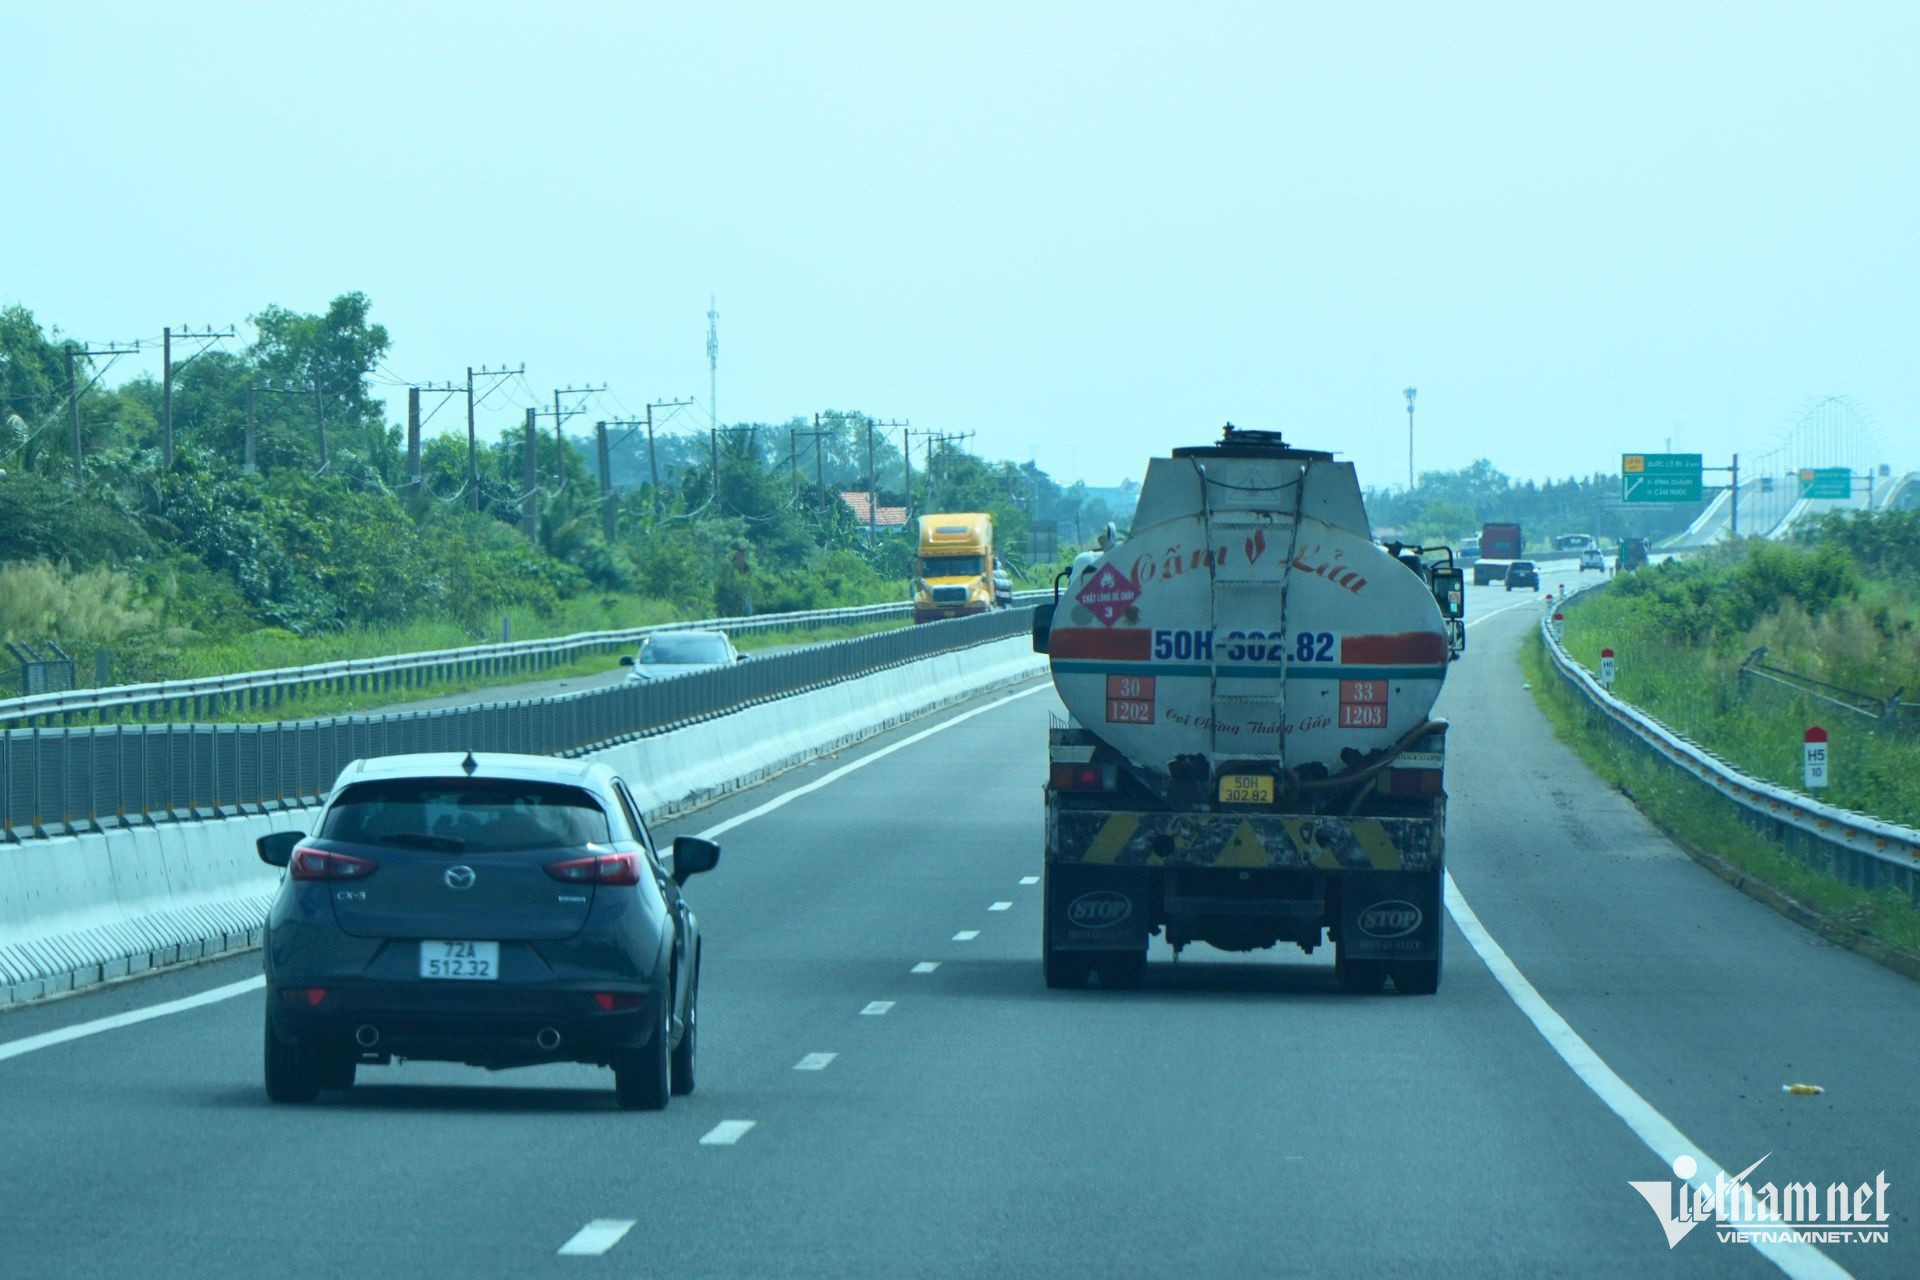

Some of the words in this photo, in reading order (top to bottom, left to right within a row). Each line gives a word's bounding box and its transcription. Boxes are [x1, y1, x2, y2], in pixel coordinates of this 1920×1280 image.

[1104, 606, 1114, 618] 3
[1155, 630, 1334, 662] 50H-302.82
[1121, 679, 1140, 697] 30
[1354, 683, 1373, 700] 33
[1112, 702, 1149, 720] 1202
[1344, 706, 1382, 724] 1203
[1807, 749, 1825, 761] H5
[1235, 776, 1258, 788] 50H
[1225, 789, 1268, 801] 302.82
[336, 891, 366, 900] CX-3
[1074, 900, 1126, 919] STOP
[1365, 909, 1418, 928] STOP
[444, 942, 476, 957] 72A
[430, 960, 489, 976] 512.32
